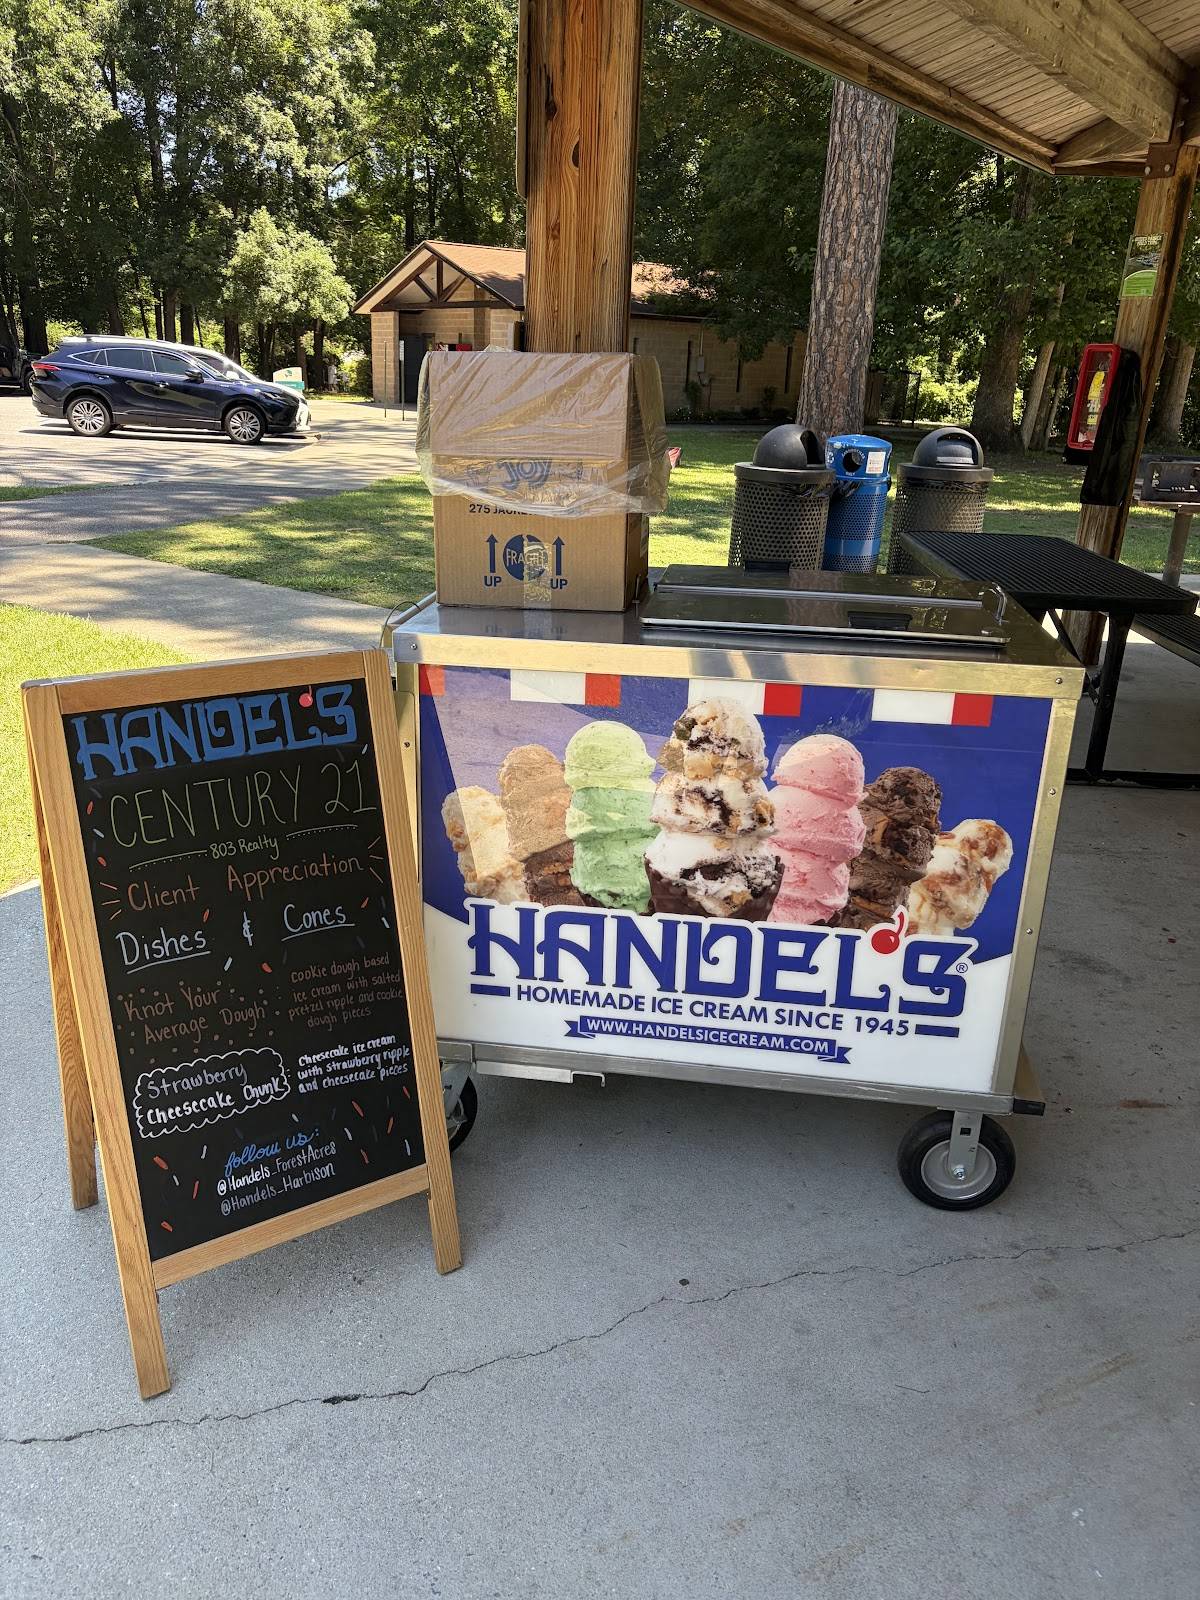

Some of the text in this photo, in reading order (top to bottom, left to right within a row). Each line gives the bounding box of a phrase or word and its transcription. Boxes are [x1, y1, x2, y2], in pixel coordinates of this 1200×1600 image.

[469, 504, 491, 514] 275
[484, 575, 502, 587] UP
[550, 578, 568, 589] UP
[71, 685, 357, 780] HANDEL'S
[110, 760, 377, 848] CENTURY 21
[209, 834, 280, 860] 803 Realty
[128, 853, 364, 911] Client Appreciation
[115, 927, 207, 966] Dishes
[283, 904, 347, 933] Cones
[331, 959, 360, 980] dough
[364, 952, 390, 968] based
[467, 902, 974, 1017] HANDEL'S
[311, 983, 341, 998] cream
[347, 976, 369, 990] with
[373, 969, 400, 985] salted
[124, 987, 221, 1022] Knot Your
[288, 987, 404, 1021] pretzel ripple and cookie
[307, 1006, 372, 1031] dough pieces
[517, 984, 909, 1036] HOMEMADE ICE CREAM SINCE 1945
[144, 1001, 266, 1045] Average Dough
[587, 1018, 829, 1053] WWW.HANDELSICECREAM.COM
[353, 1042, 366, 1054] ice
[367, 1034, 396, 1049] cream
[298, 1044, 410, 1080] with strawberry ripple
[298, 1063, 408, 1094] and cheesecake pieces
[147, 1064, 248, 1099] Strawberry
[147, 1091, 235, 1125] Cheesecake
[217, 1141, 337, 1196] @Handels_ForestAcres
[224, 1141, 282, 1178] follow
[221, 1162, 336, 1216] @Handels_Harbison
